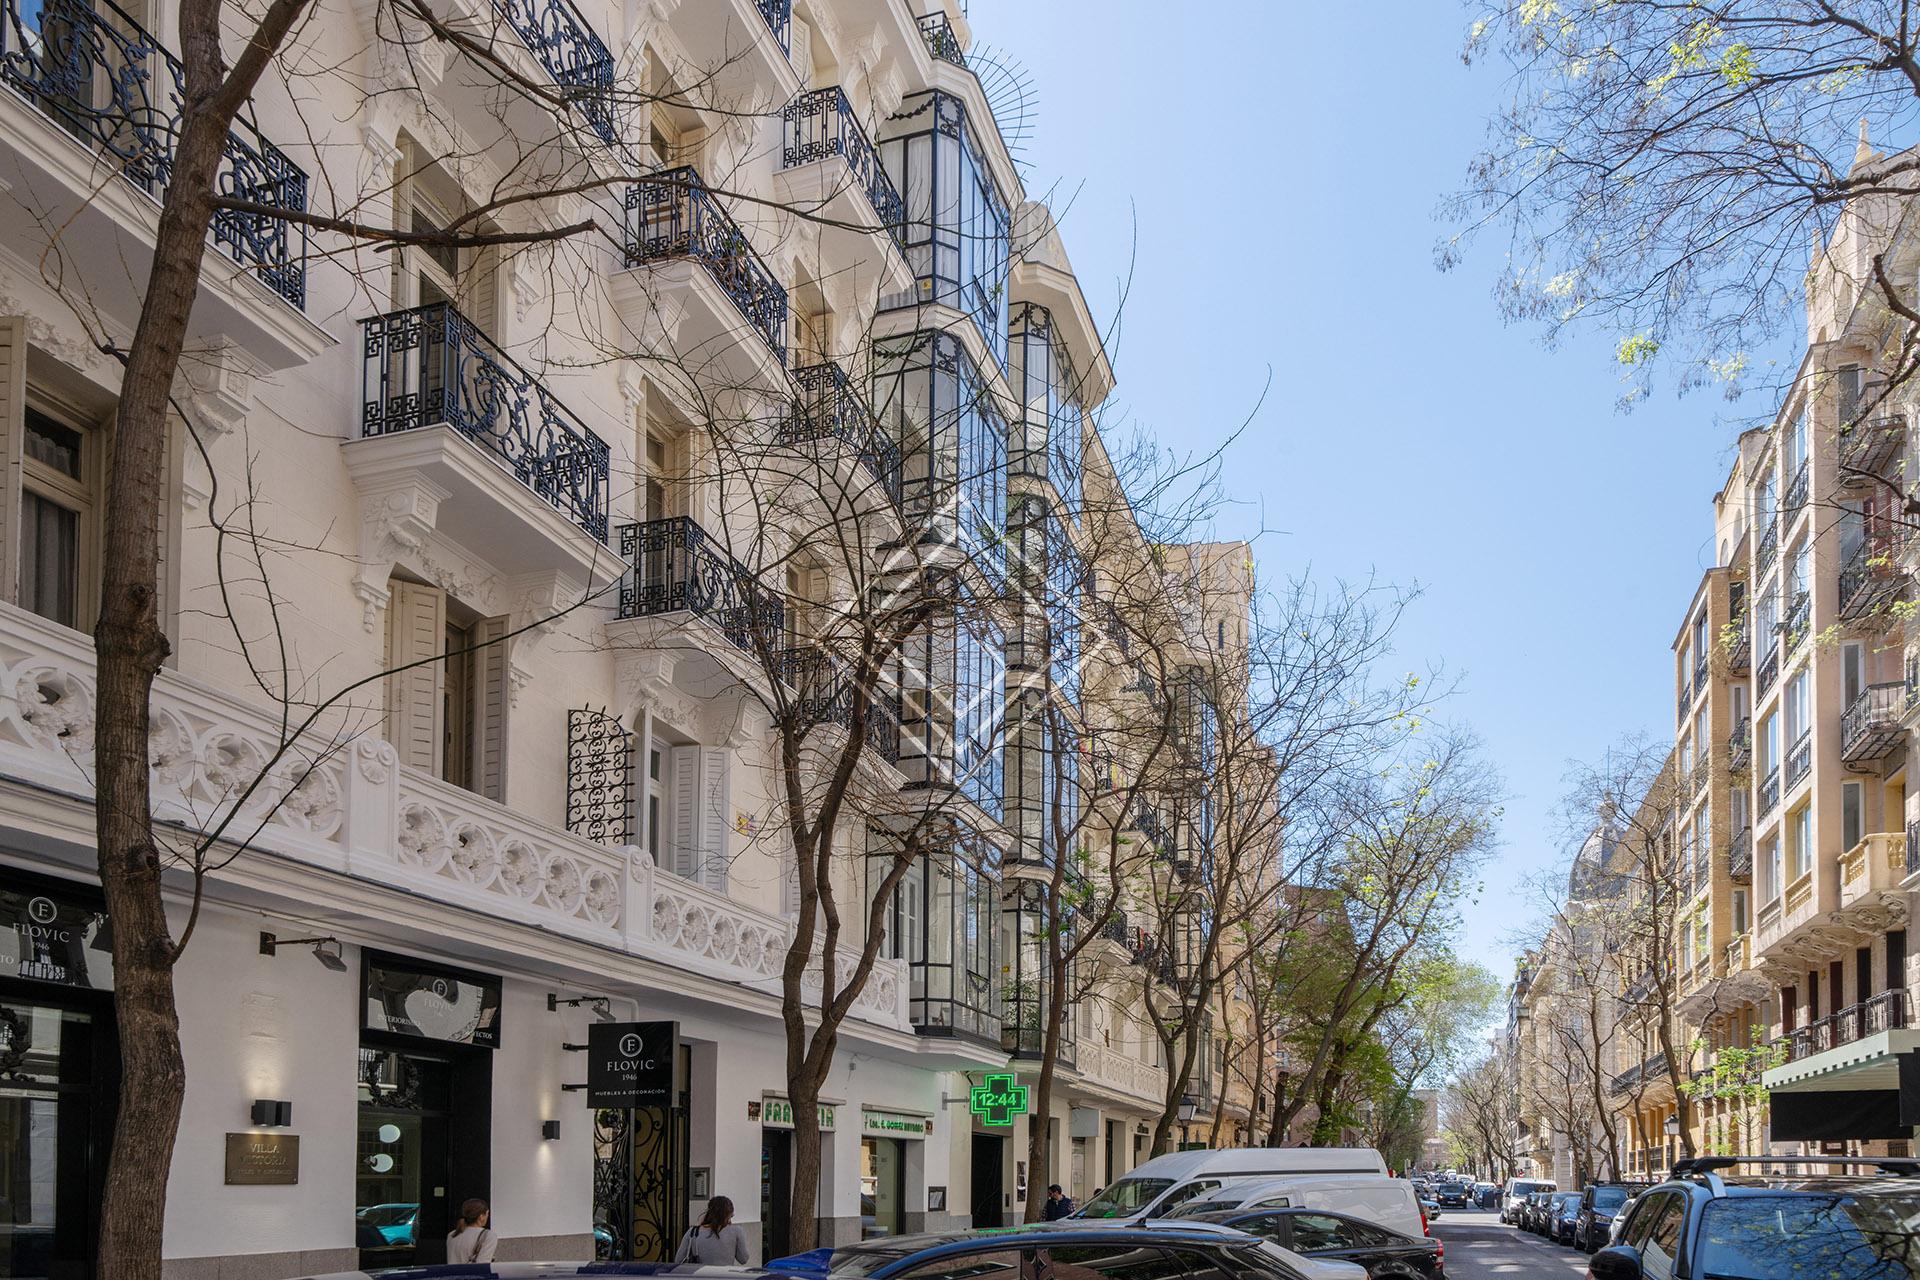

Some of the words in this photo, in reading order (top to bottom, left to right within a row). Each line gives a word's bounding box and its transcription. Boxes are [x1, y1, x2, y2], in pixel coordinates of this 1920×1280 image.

[13, 923, 69, 942] FLOVIC
[606, 1059, 655, 1072] FLOVIC
[622, 1073, 638, 1081] 1946
[978, 1092, 1017, 1106] 12:44
[250, 1143, 280, 1154] VILLA
